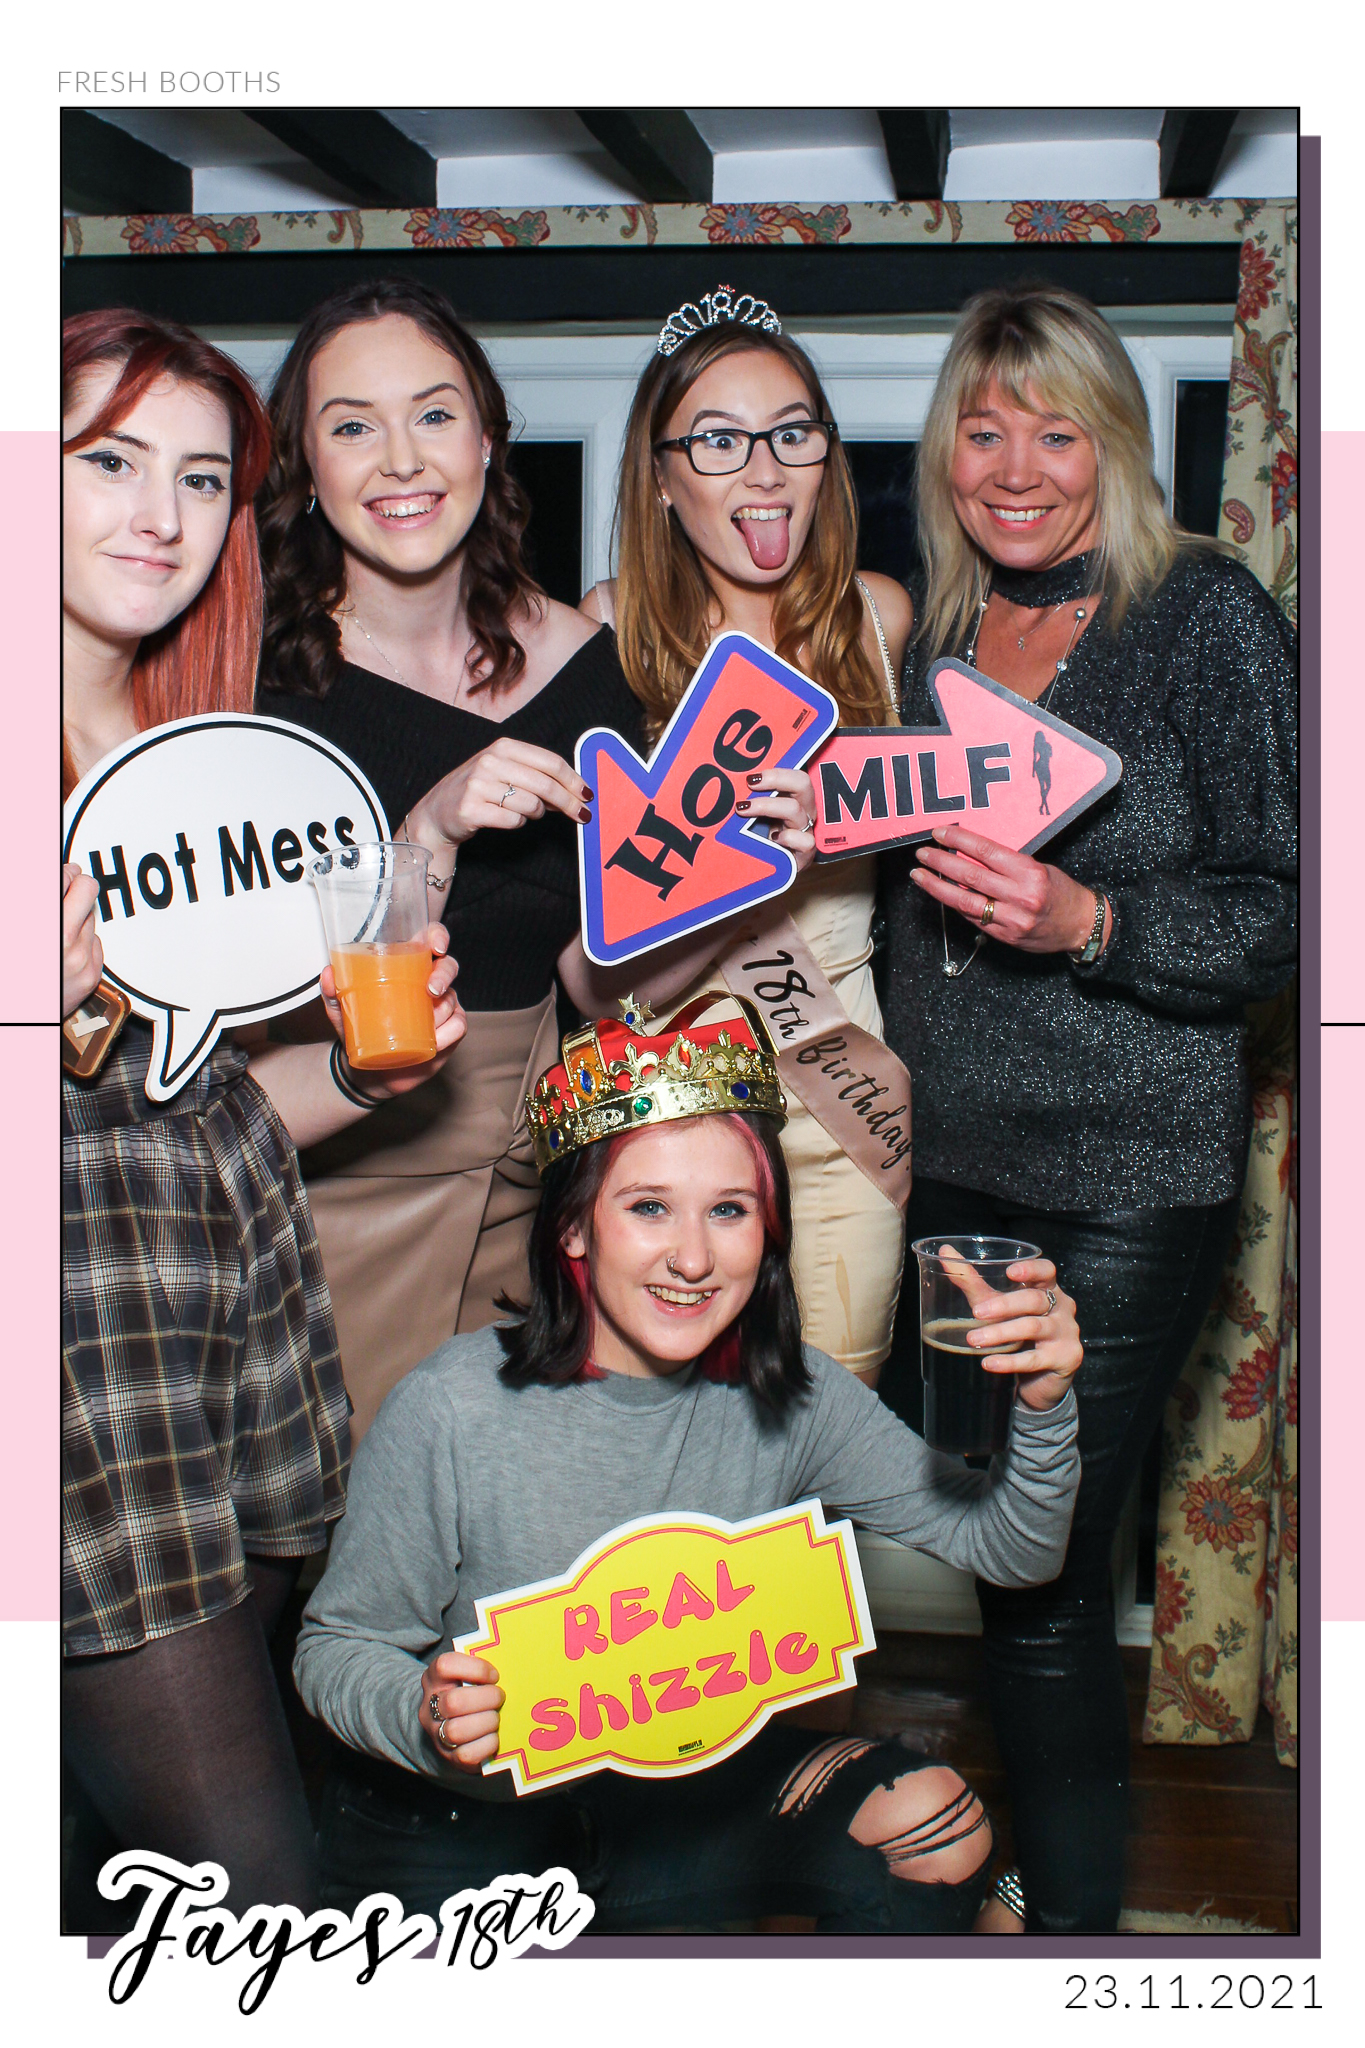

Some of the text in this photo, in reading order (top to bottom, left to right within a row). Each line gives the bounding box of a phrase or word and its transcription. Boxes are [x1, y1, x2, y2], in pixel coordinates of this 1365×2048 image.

[604, 708, 773, 902] Hoe
[819, 742, 1012, 825] MILF
[88, 815, 361, 923] Hot Mess
[741, 950, 816, 1041] 18th
[564, 1559, 756, 1661] REAL
